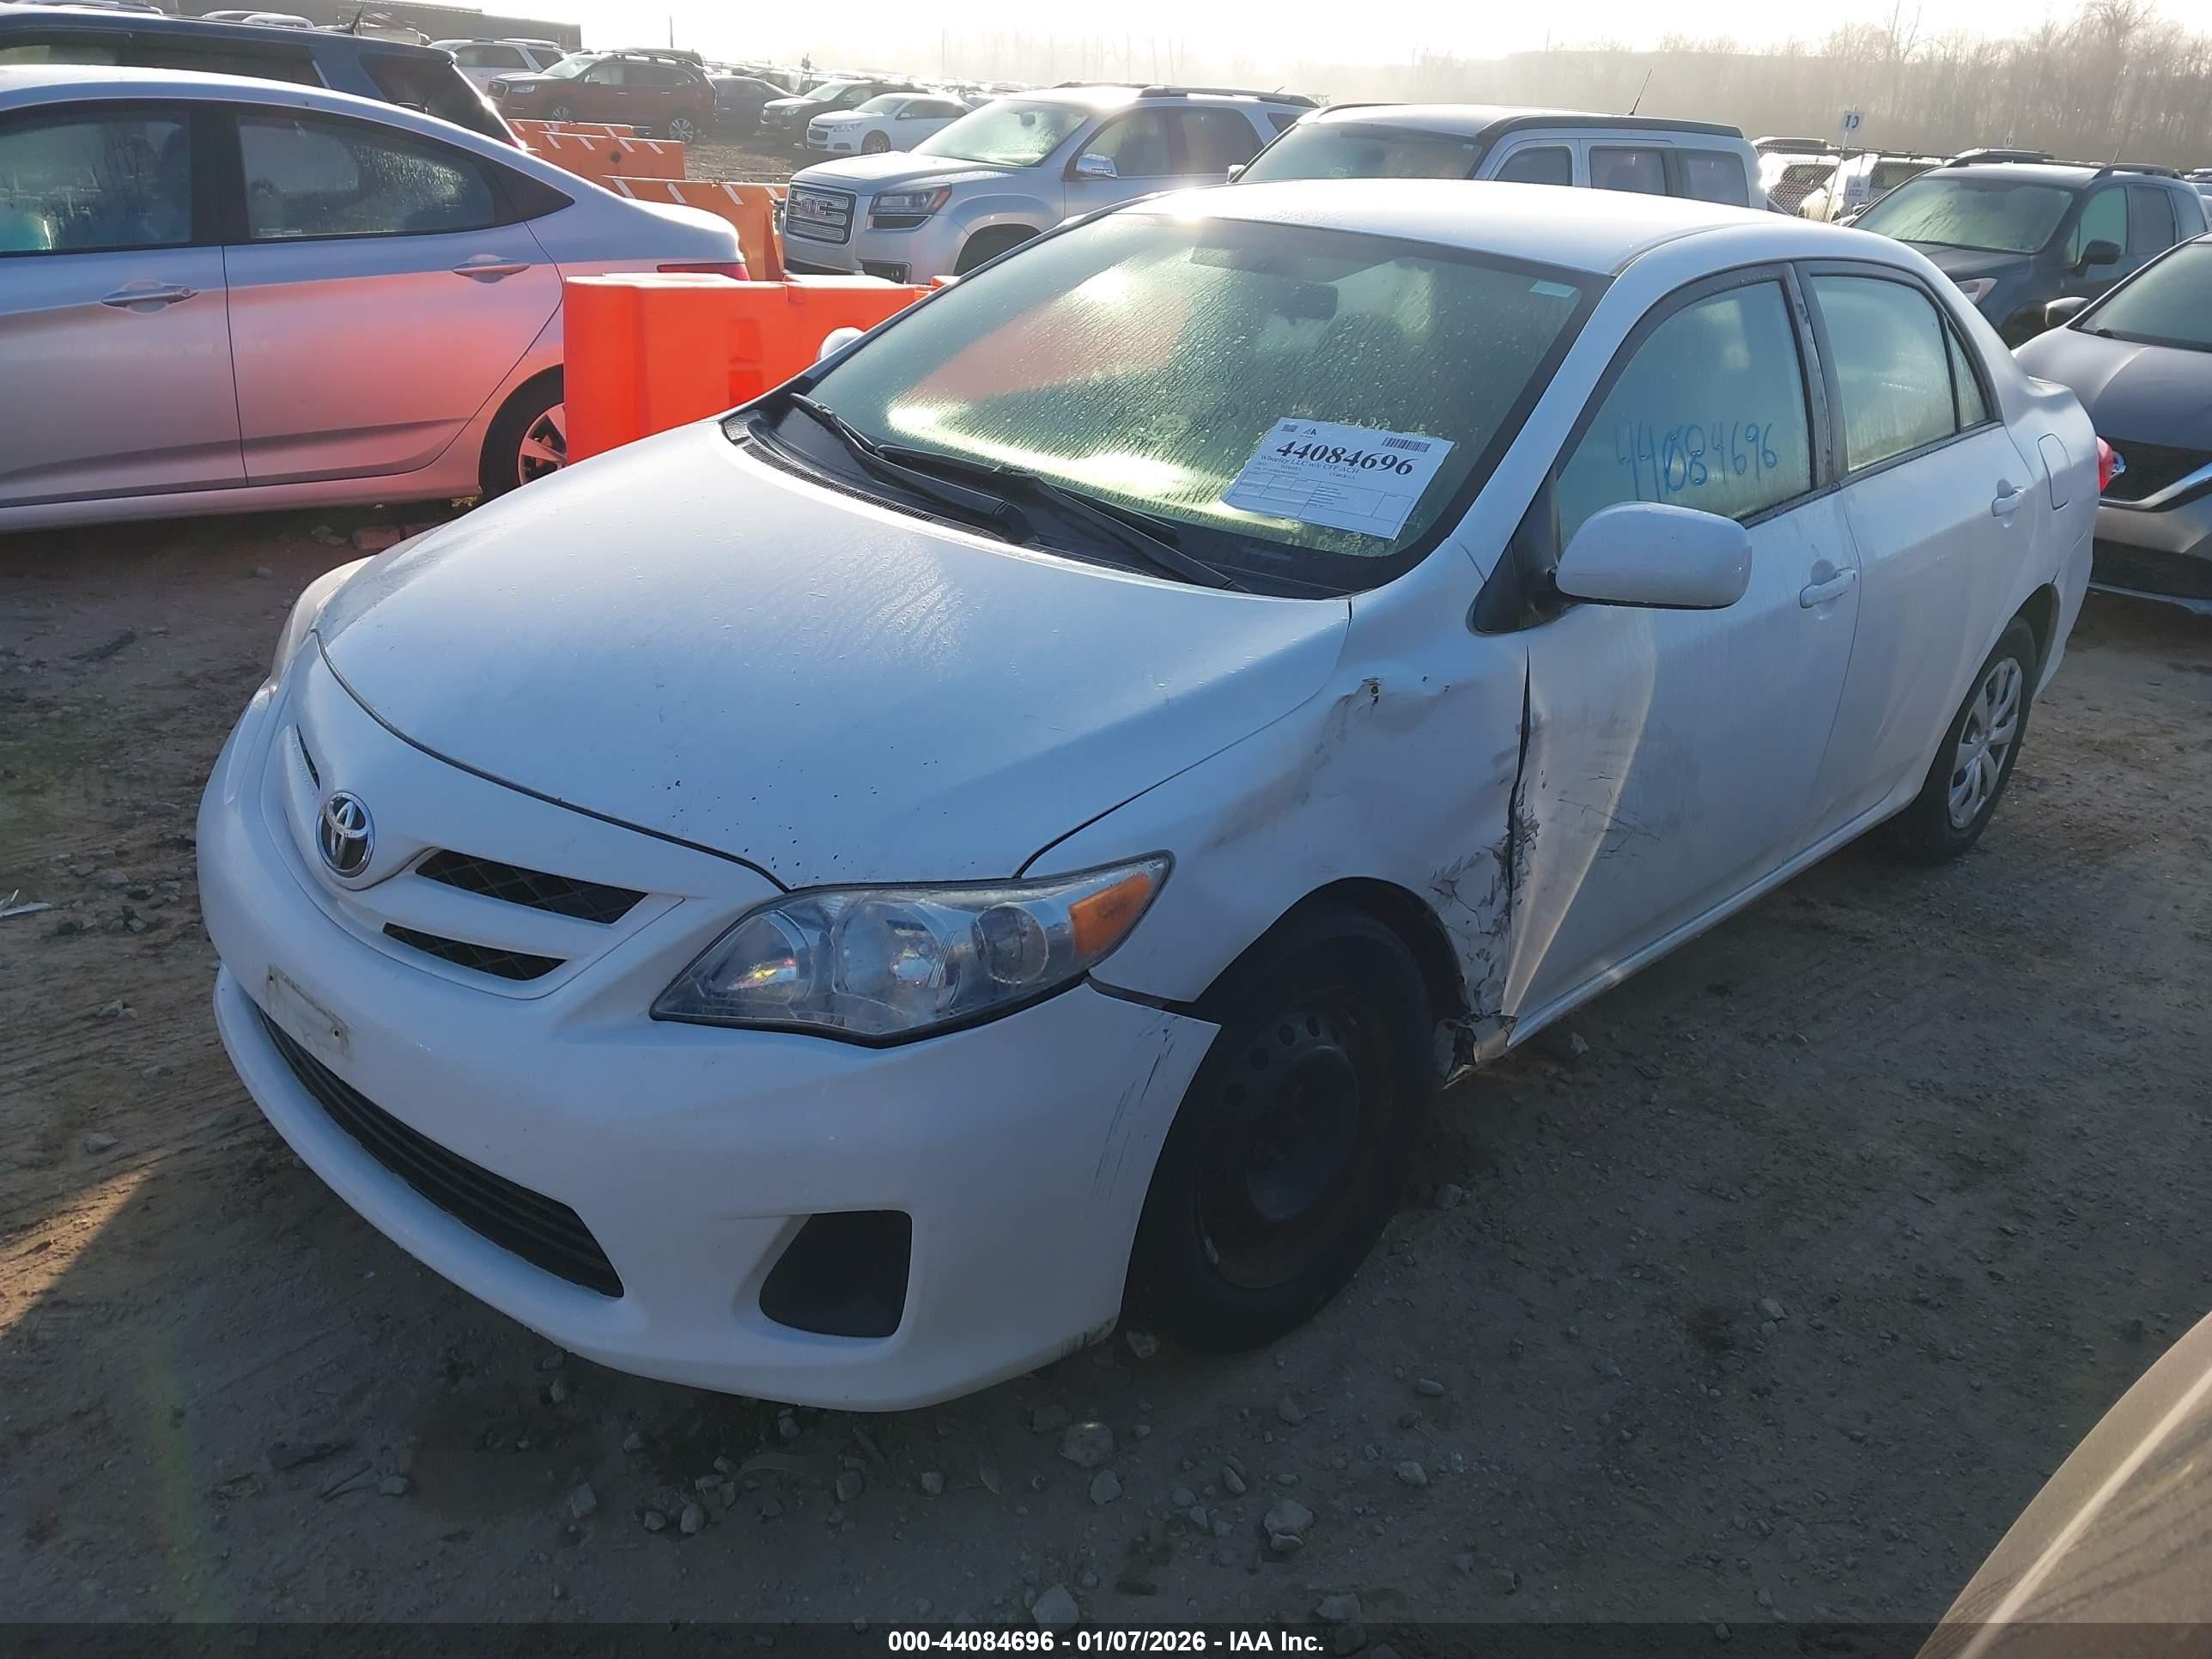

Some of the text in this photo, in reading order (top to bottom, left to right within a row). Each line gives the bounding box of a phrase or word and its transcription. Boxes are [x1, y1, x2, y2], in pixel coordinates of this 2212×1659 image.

[801, 198, 828, 216] GMC
[1276, 441, 1418, 476] 44084696
[1614, 419, 1778, 501] 44084696
